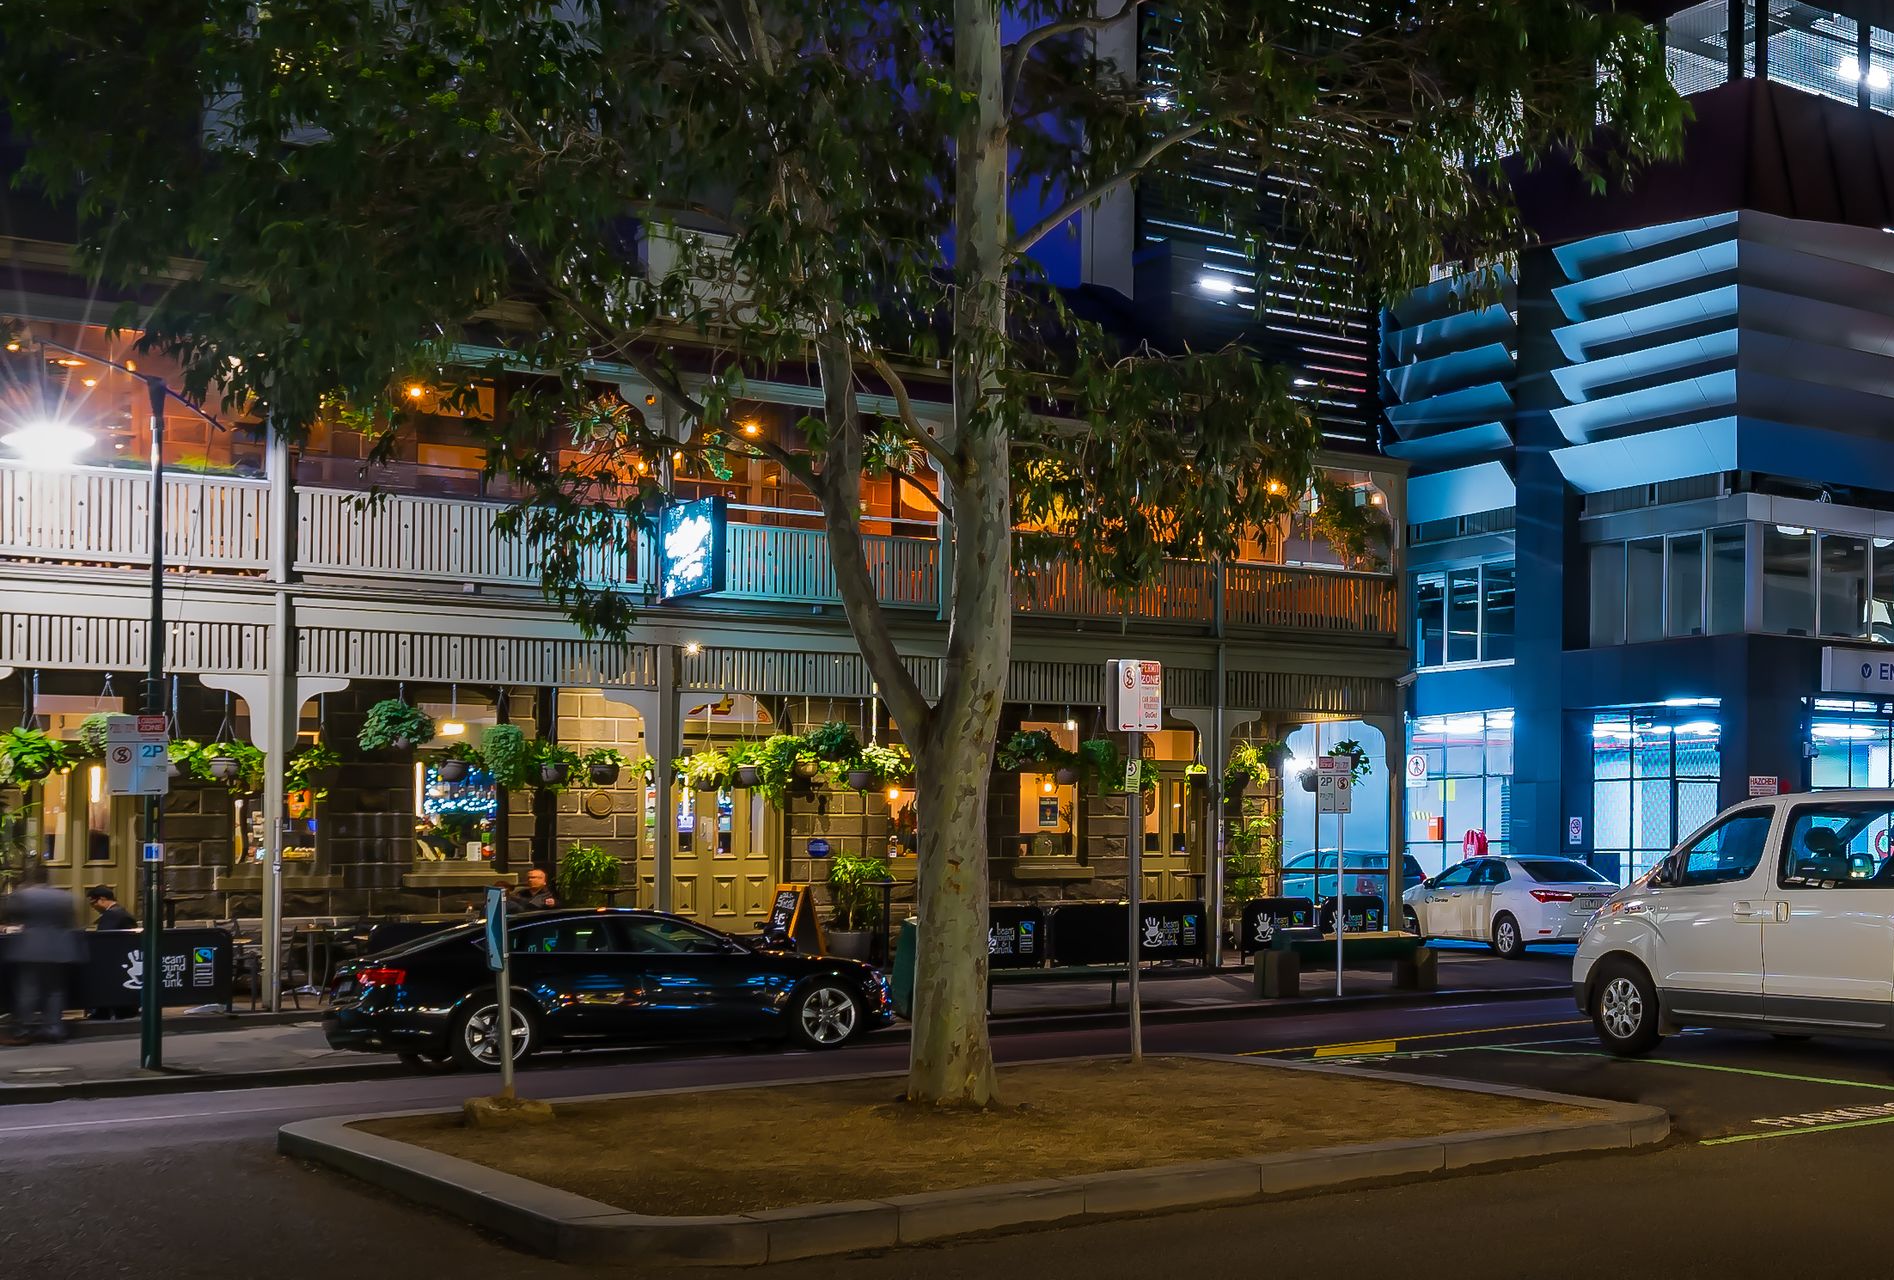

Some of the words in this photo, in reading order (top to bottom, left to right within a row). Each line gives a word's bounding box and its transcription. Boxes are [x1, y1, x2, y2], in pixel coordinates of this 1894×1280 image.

[1141, 675, 1159, 684] ZONE
[142, 744, 164, 758] 2P
[1320, 776, 1333, 787] 2P
